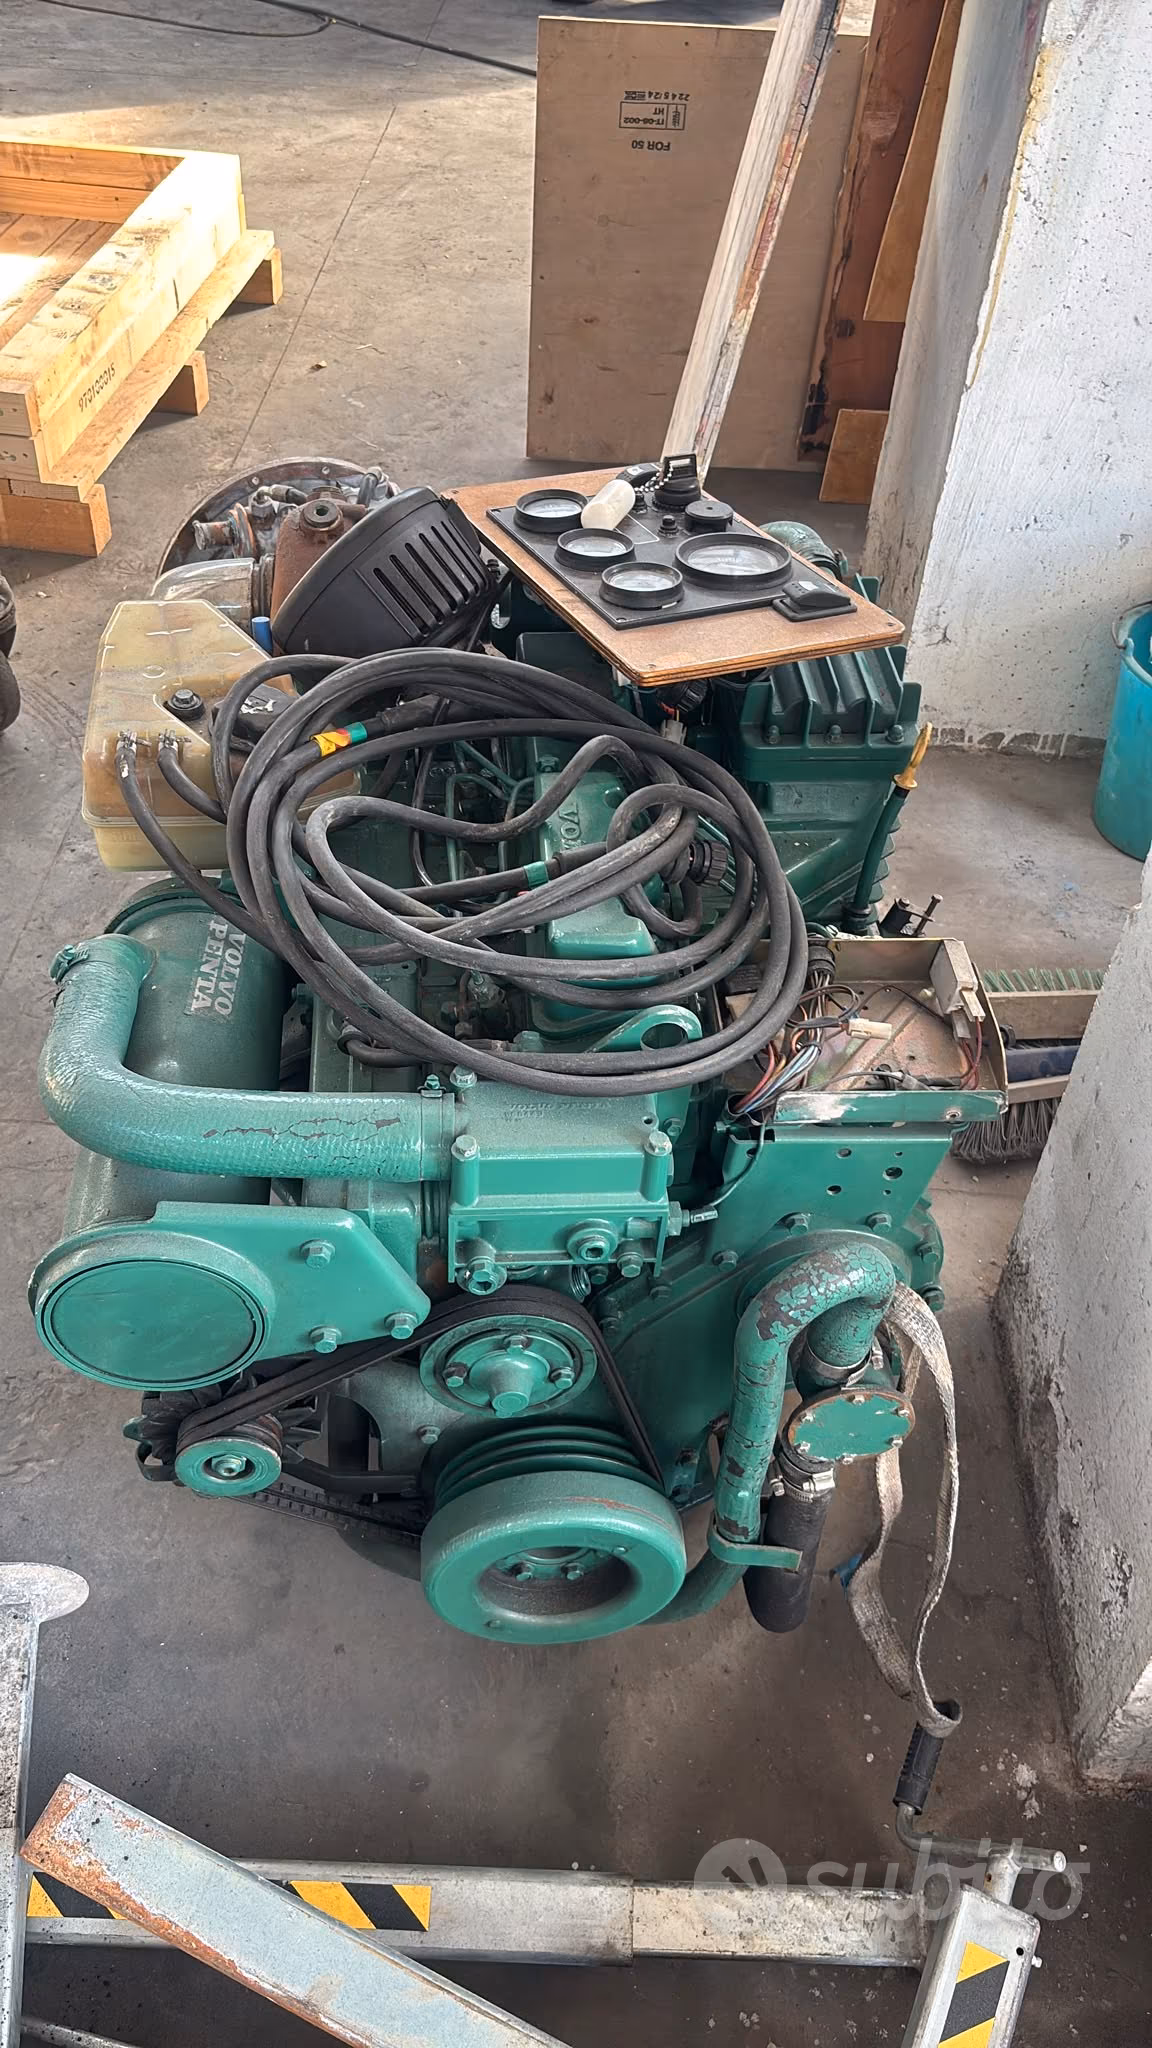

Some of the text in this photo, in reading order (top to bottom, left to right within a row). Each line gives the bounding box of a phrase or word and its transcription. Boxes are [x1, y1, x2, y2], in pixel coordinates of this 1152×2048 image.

[652, 107, 665, 115] HT
[631, 140, 671, 152] FOR 50
[190, 920, 229, 1012] PENTA
[214, 932, 247, 1016] VOLVO
